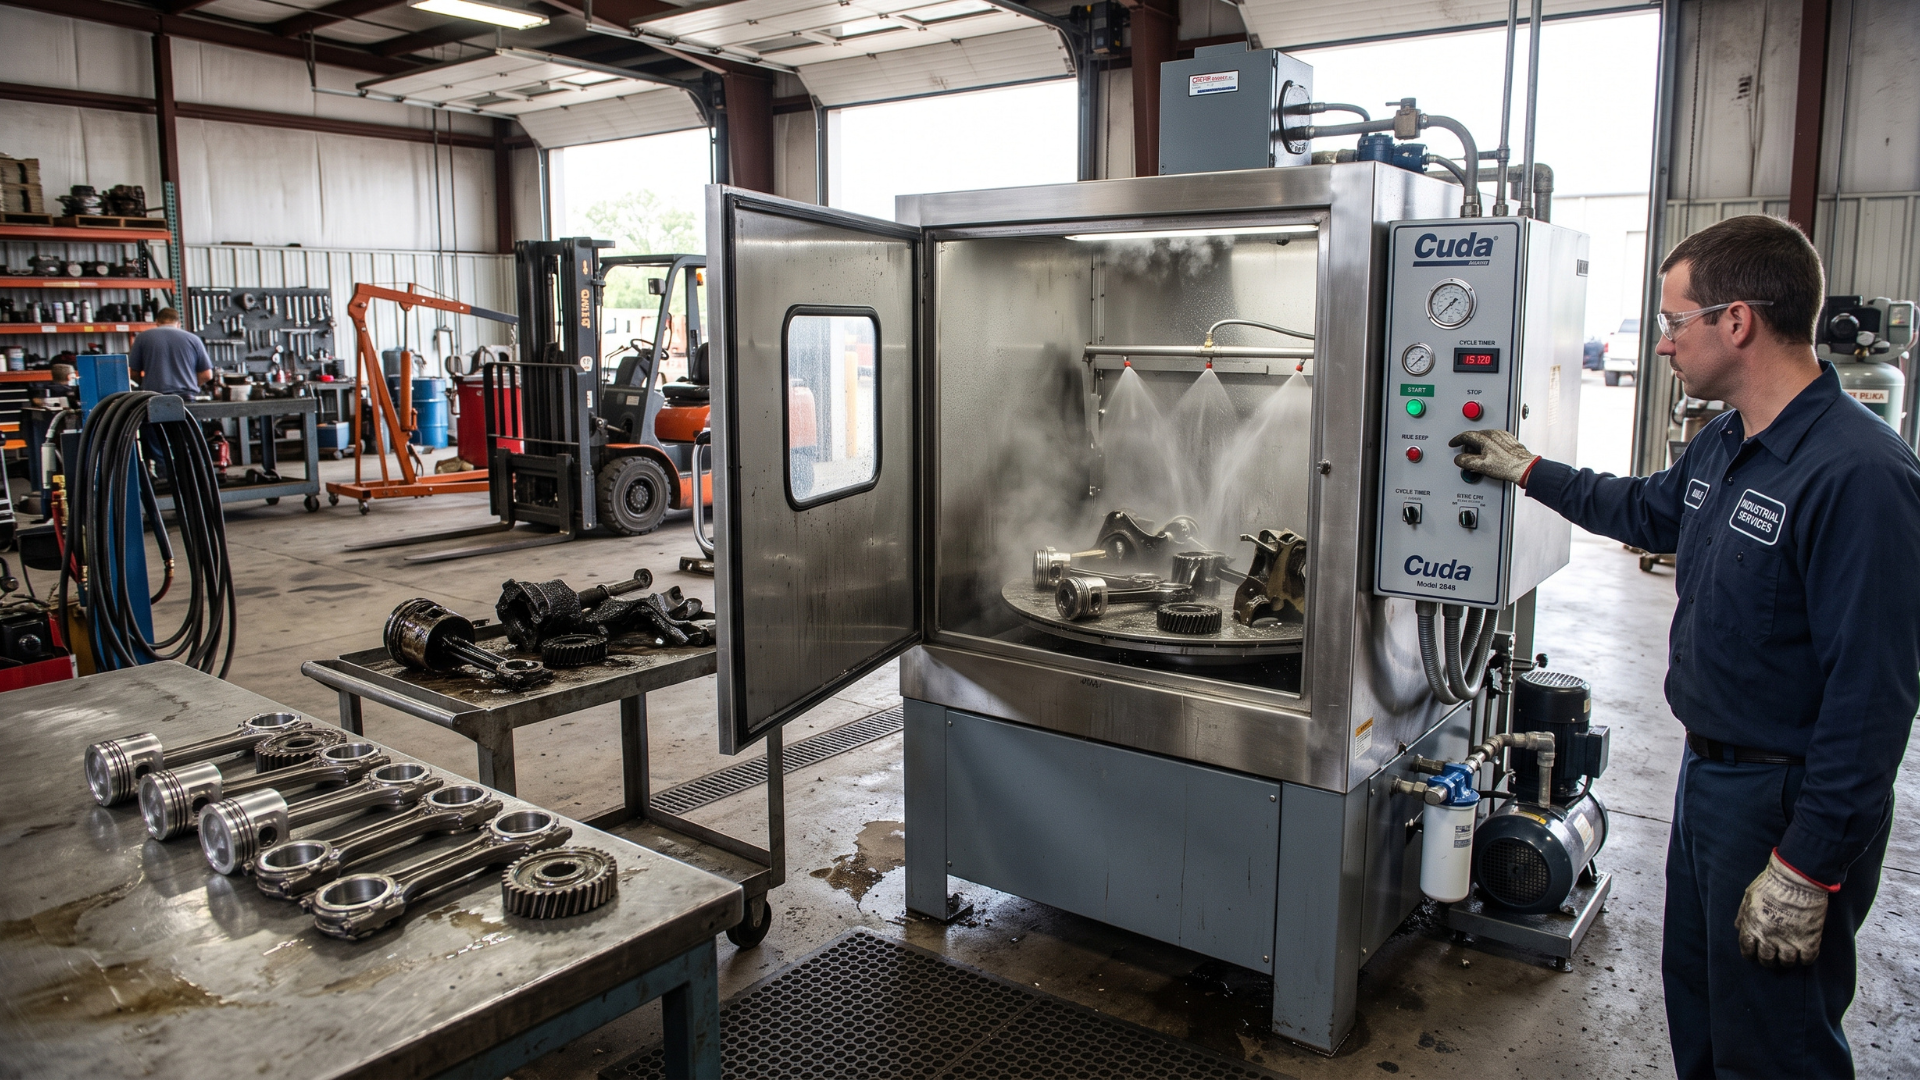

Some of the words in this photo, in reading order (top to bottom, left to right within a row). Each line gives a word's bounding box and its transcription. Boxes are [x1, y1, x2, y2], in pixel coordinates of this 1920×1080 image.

[1414, 232, 1494, 259] Cuda
[1737, 510, 1773, 533] SERVICES
[1740, 498, 1779, 524] INDUSTRIAL
[1404, 554, 1471, 581] Cuda
[1416, 580, 1438, 589] Model
[1438, 583, 1456, 591] 2848
